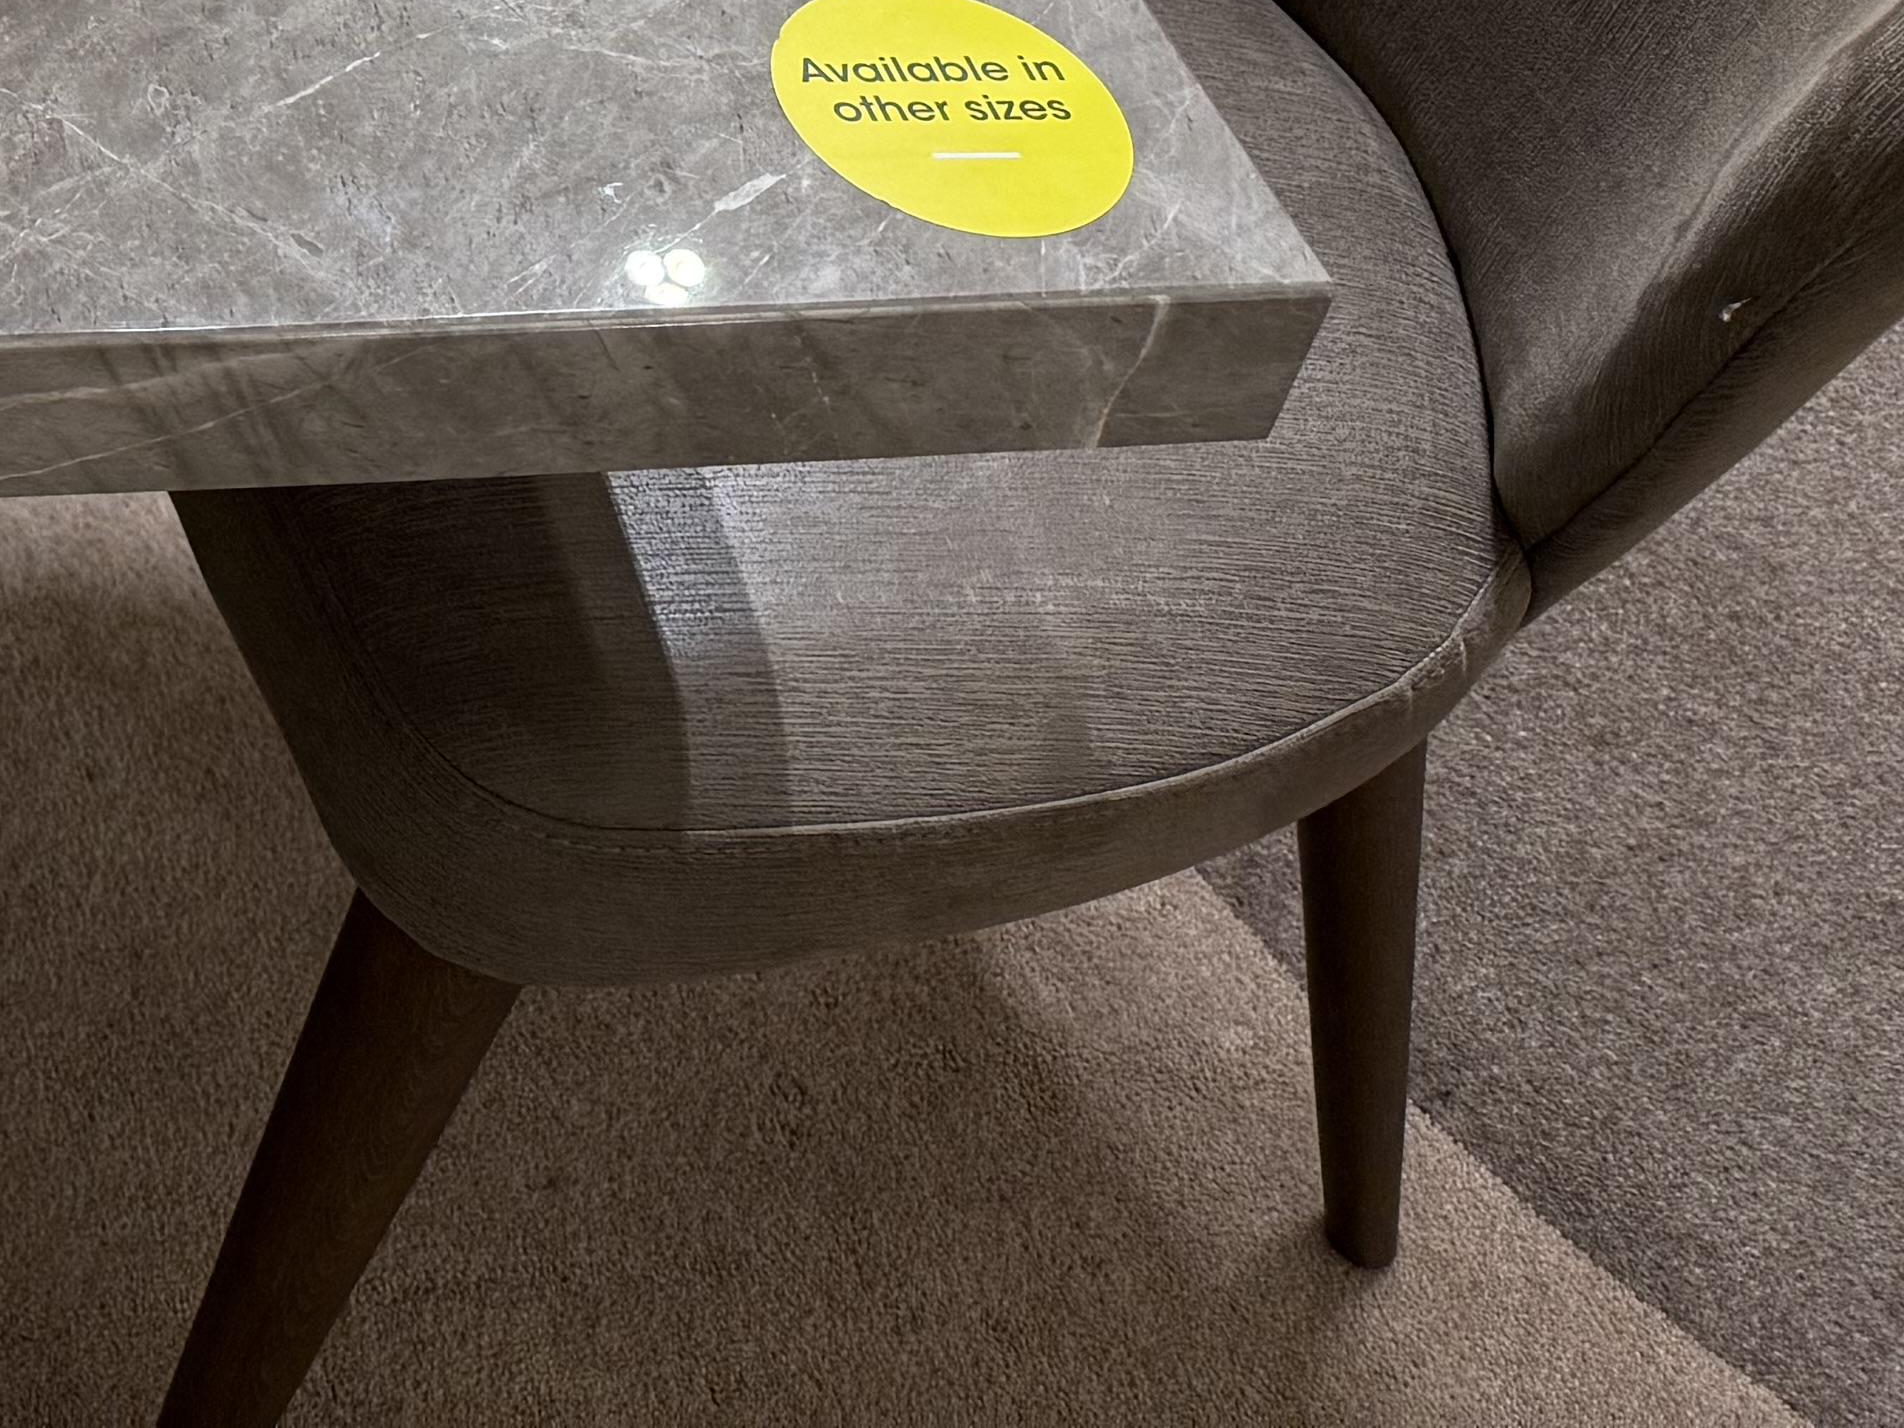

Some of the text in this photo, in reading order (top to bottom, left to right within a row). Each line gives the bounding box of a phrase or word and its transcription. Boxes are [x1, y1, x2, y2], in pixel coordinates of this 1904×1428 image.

[802, 56, 1065, 82] Available in
[833, 95, 1072, 122] other sizes
